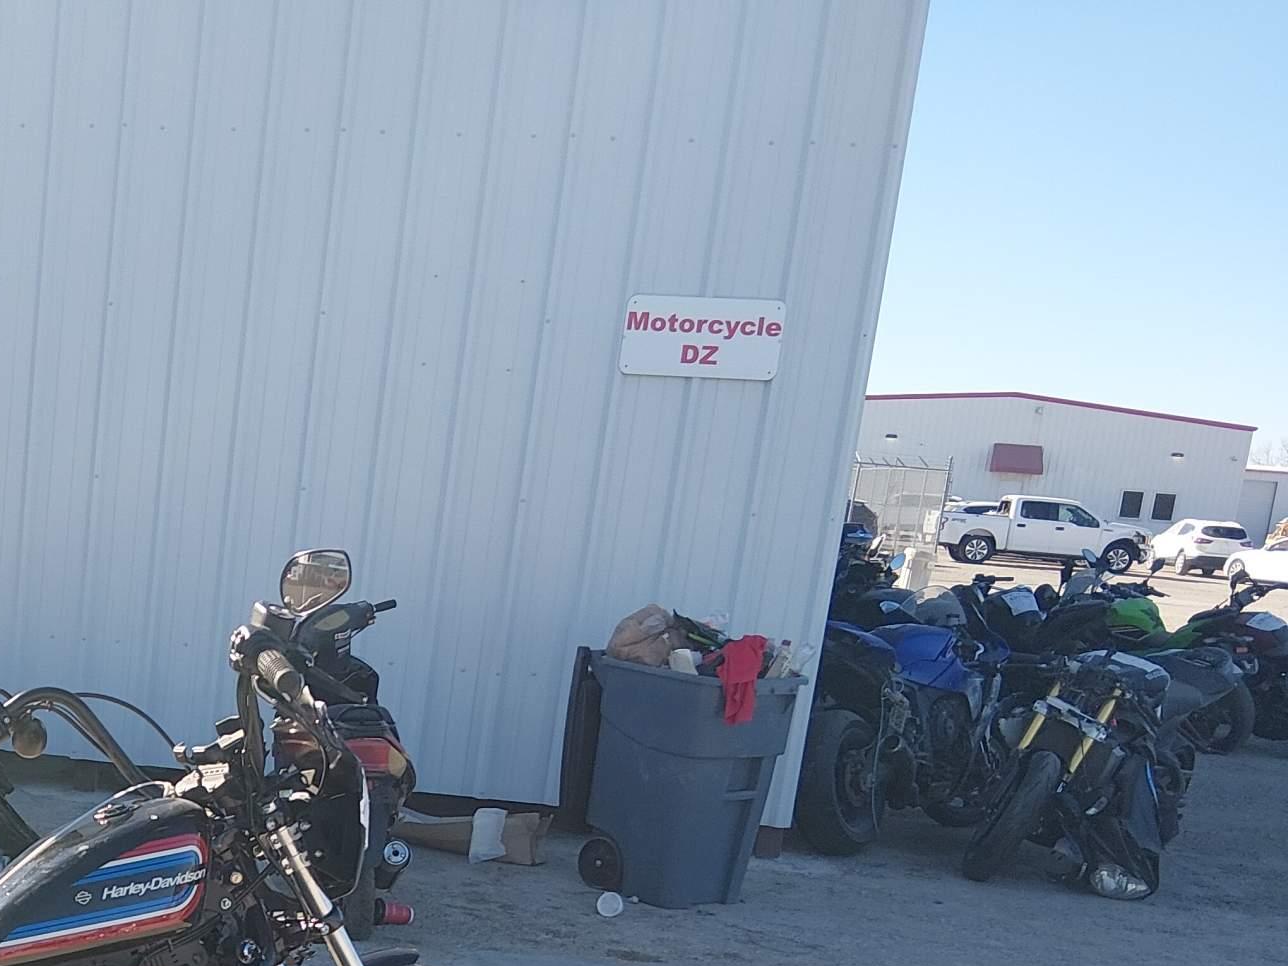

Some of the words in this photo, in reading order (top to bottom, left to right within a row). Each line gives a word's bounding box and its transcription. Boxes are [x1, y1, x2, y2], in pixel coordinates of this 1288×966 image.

[626, 311, 782, 340] Motorcycle
[680, 344, 719, 365] DZ
[101, 868, 206, 900] Harley-Davidson
